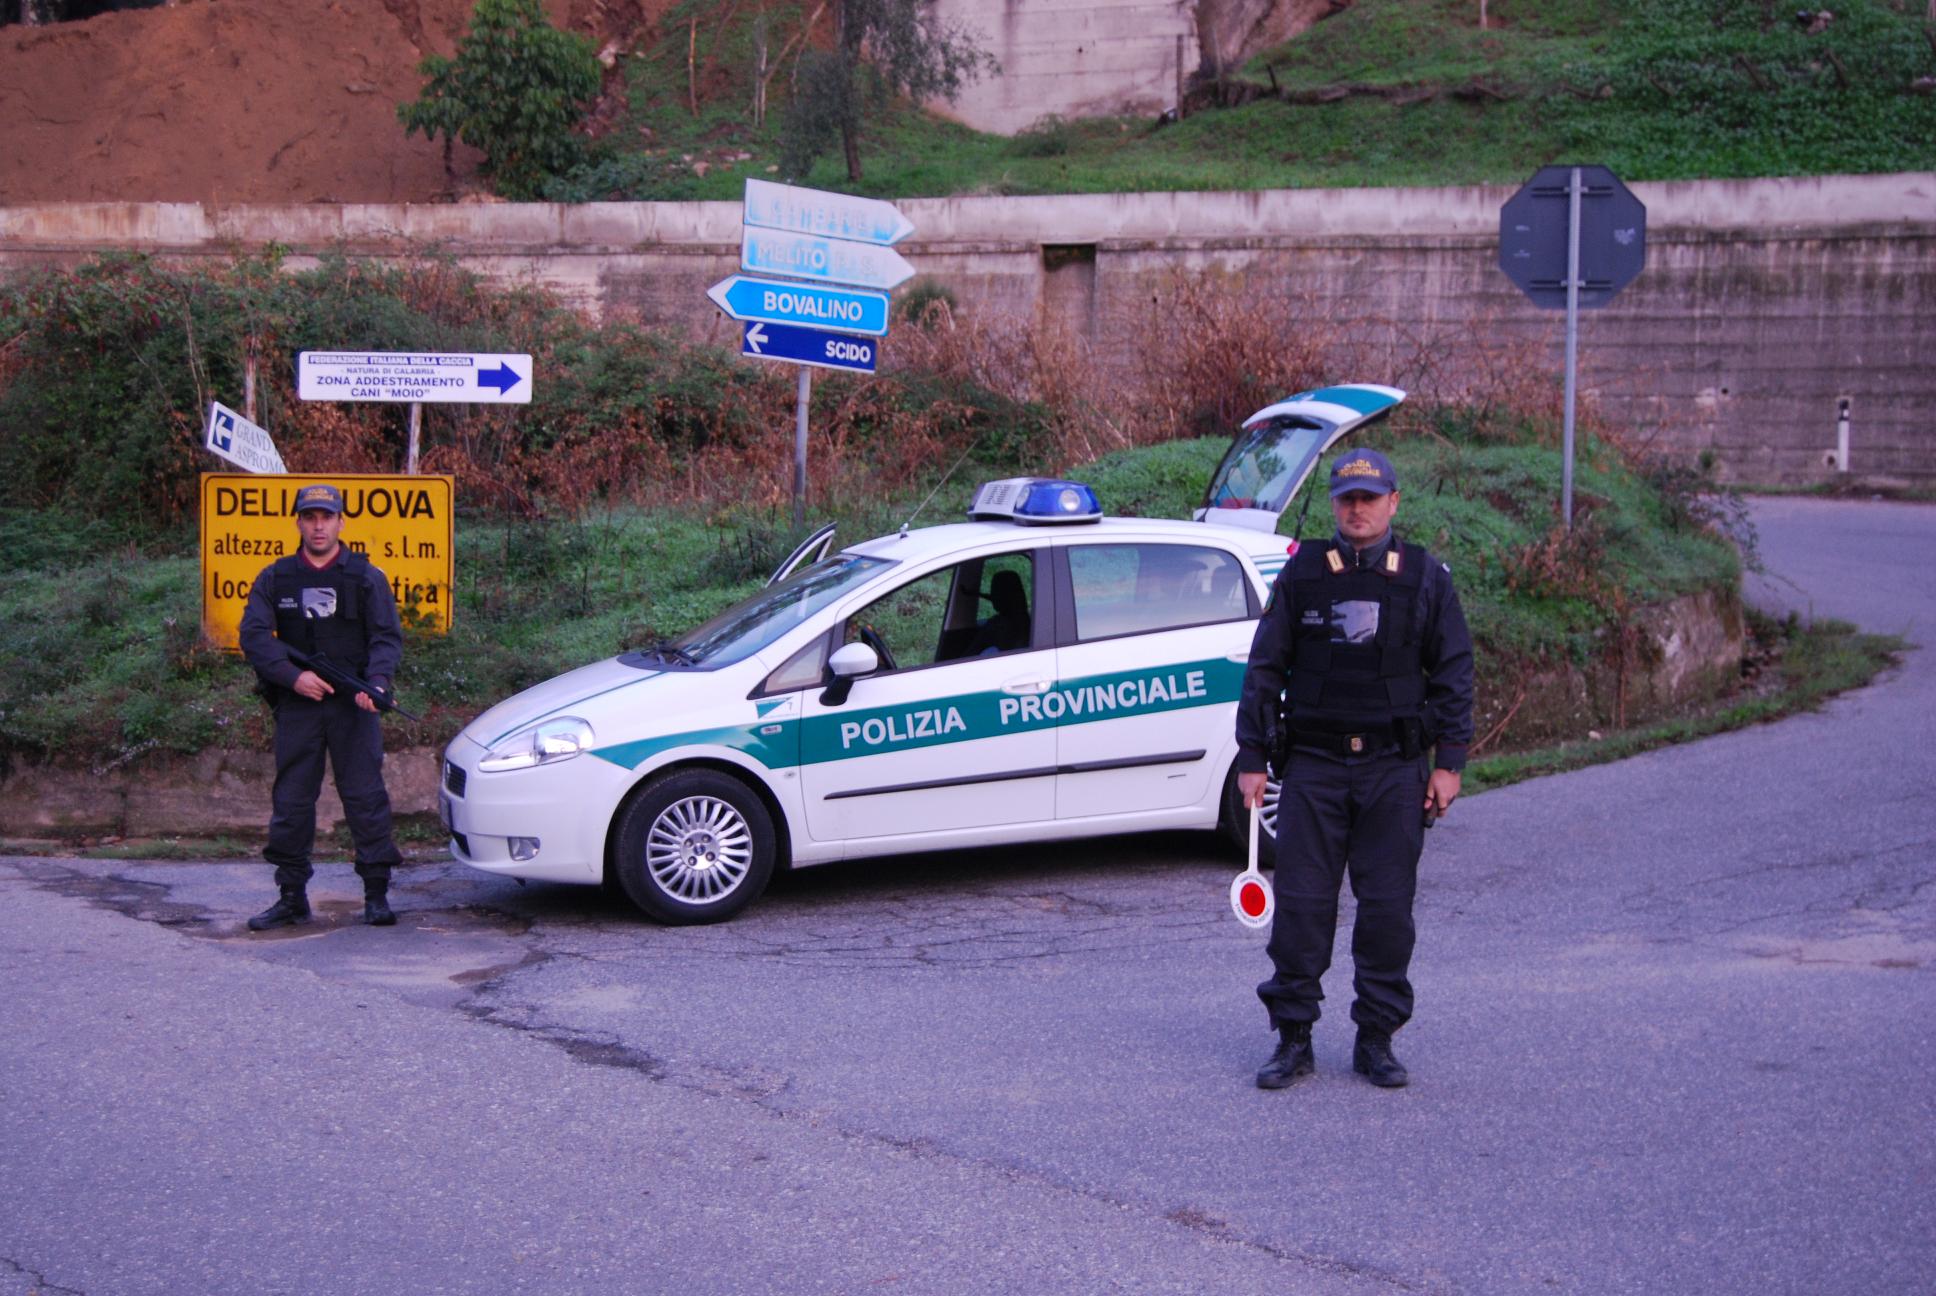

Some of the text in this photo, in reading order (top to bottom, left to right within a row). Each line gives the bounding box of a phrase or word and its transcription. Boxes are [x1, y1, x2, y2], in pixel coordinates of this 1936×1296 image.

[759, 245, 826, 268] MELITO
[764, 291, 863, 321] BOVALINO
[310, 355, 472, 366] FEDERAZIONE ITALIANA DELLA CACCIA
[825, 340, 871, 363] SCIDO
[317, 376, 464, 387] ZONA ADDESTRAMENTO
[351, 388, 430, 398] CANI "MOIO"
[236, 421, 271, 452] GRAND
[217, 487, 434, 519] DELIUOVA
[214, 532, 284, 556] altezza
[841, 671, 1207, 749] POLIZIA PROVINCIALE
